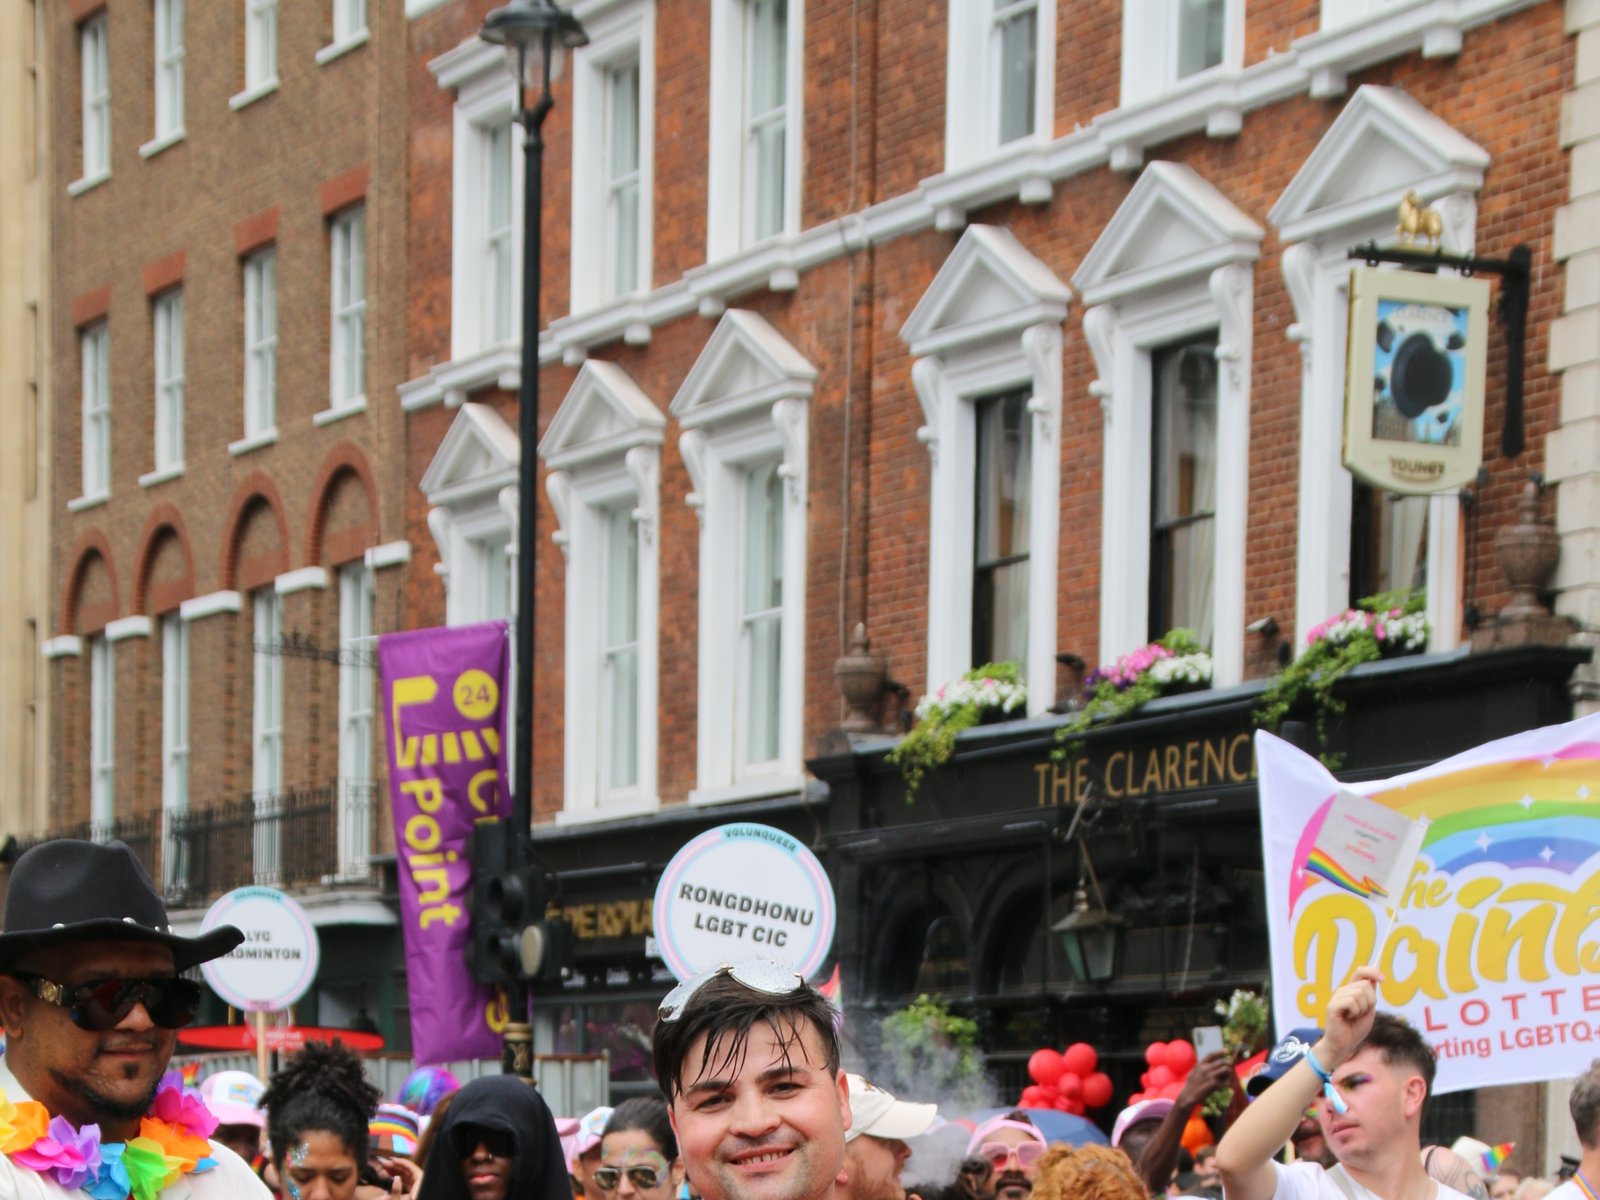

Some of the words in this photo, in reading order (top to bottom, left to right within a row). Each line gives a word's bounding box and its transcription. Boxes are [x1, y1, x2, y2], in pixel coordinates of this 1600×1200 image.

[460, 684, 490, 705] 24
[1034, 758, 1088, 805] THE
[1105, 733, 1258, 798] CLARENC
[400, 777, 461, 930] Point
[724, 827, 798, 852] VOLUNQUEER
[1386, 858, 1451, 912] he
[678, 882, 815, 926] RONGDHONU
[694, 913, 748, 938] LGBT
[752, 925, 788, 947] CIC
[221, 948, 301, 960] ADMINTON
[1430, 1036, 1491, 1059] rting
